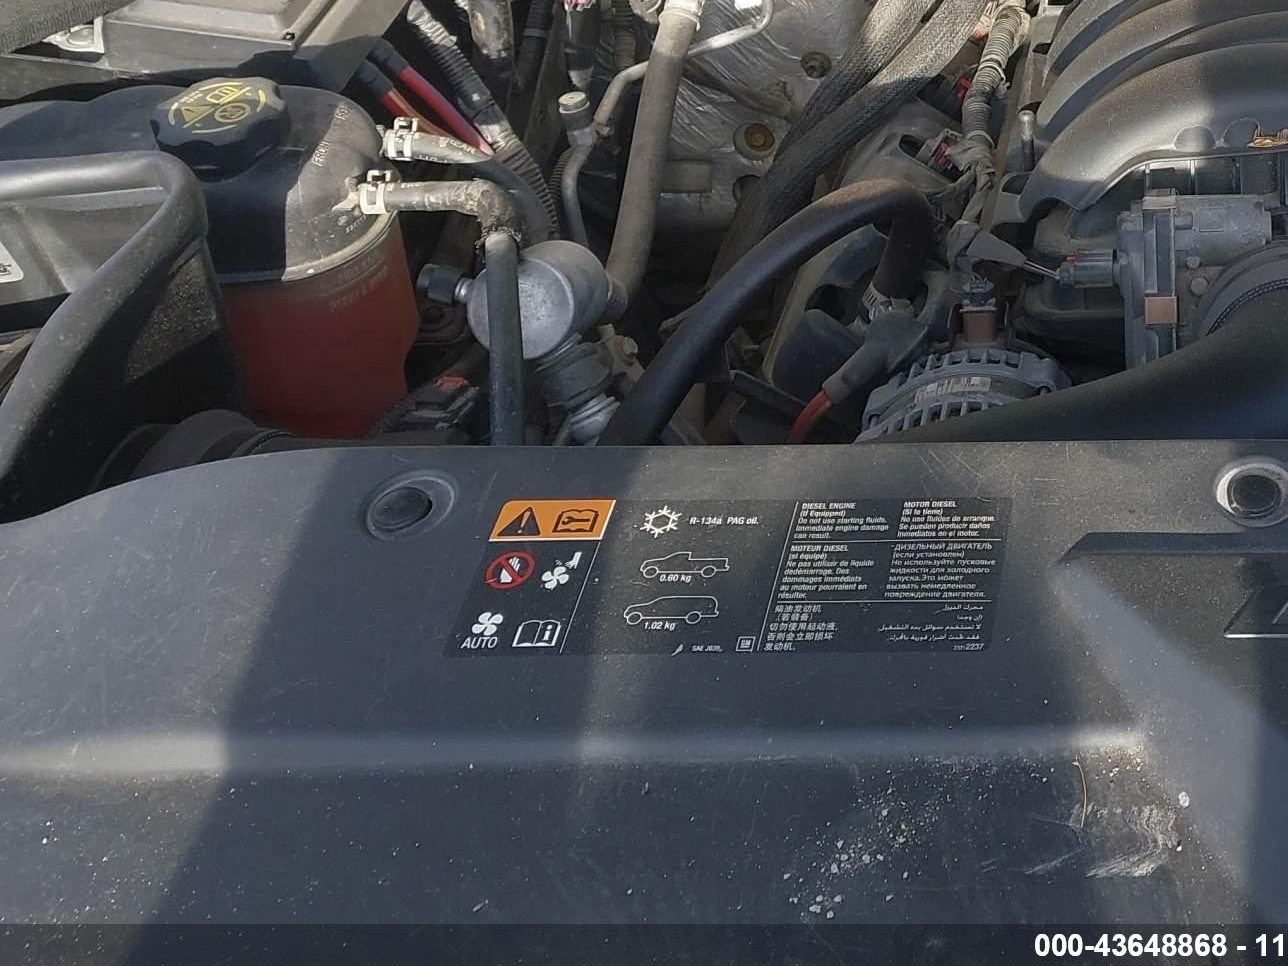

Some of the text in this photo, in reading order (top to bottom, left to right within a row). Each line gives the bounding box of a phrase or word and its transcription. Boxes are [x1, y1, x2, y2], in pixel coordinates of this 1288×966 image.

[690, 517, 722, 525] R-134a
[659, 574, 692, 583] 0.60 kg
[644, 621, 676, 631] 1.02 kg
[460, 636, 498, 649] AUTO
